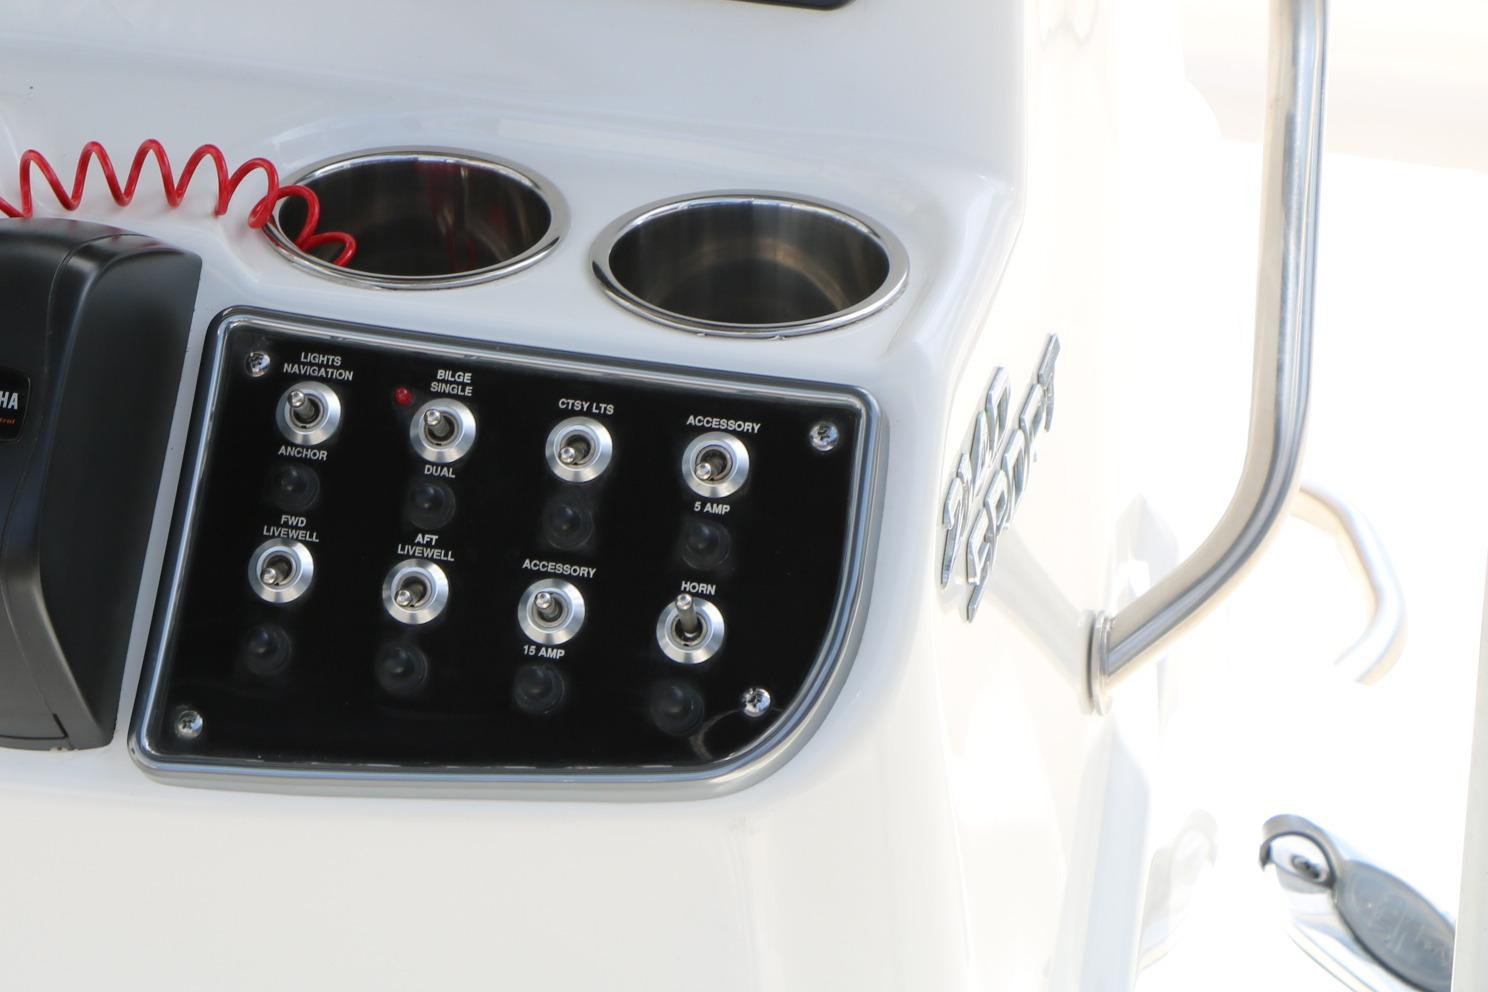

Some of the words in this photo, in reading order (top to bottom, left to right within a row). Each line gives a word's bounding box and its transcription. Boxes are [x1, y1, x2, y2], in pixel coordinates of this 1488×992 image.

[300, 352, 342, 366] LIGHTS
[283, 363, 354, 381] NAVIGATION
[436, 369, 472, 383] BILGE
[430, 382, 473, 396] SINGLE
[558, 398, 590, 412] CTSY
[592, 402, 614, 415] LTS
[686, 414, 761, 434] ACCESSORY
[278, 445, 328, 461] ANCHOR
[424, 464, 456, 478] DUAL
[693, 501, 701, 512] 5
[703, 502, 730, 516] AMP
[280, 514, 307, 528] FWD
[263, 525, 320, 543] LIVEWELL
[415, 533, 439, 546] AFT
[397, 543, 455, 562] LIVEWELL
[522, 558, 597, 579] ACCESSORY
[680, 580, 716, 595] HORN
[522, 644, 536, 656] 15
[538, 646, 565, 660] AMP
